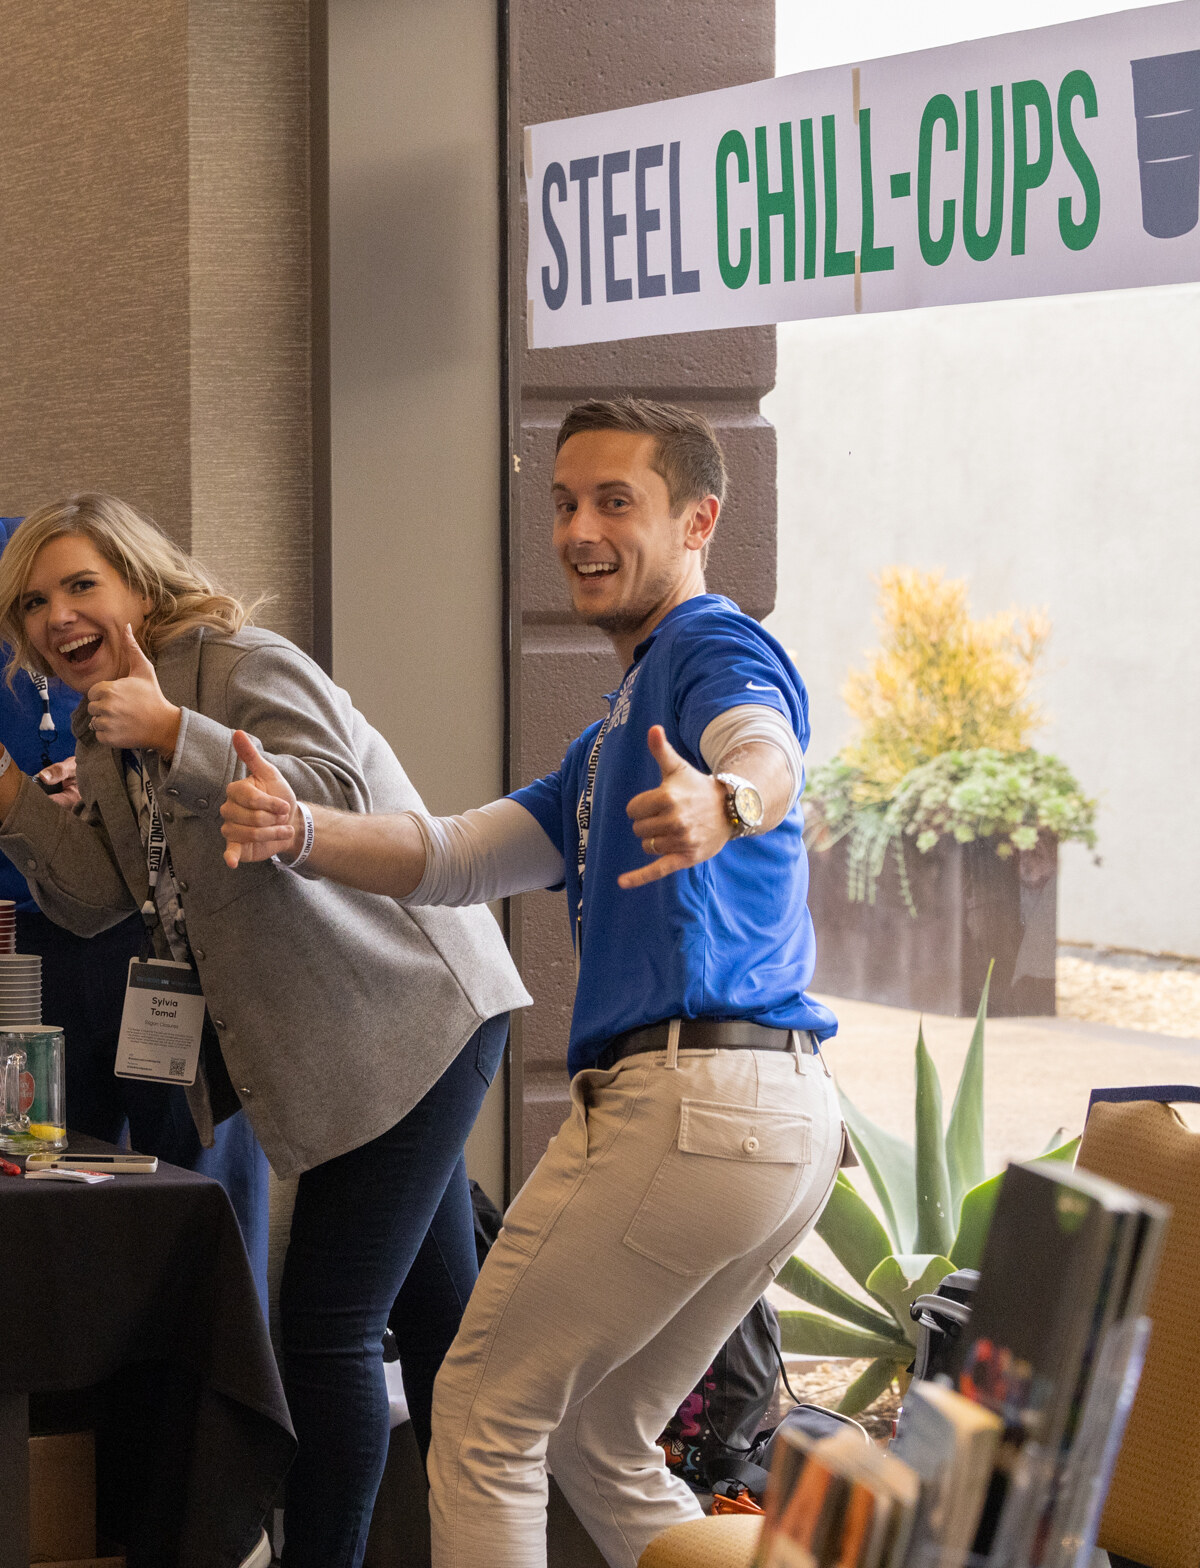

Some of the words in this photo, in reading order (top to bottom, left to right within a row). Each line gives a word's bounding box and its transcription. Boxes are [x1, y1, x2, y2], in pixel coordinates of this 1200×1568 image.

[541, 141, 701, 310] STEEL
[715, 69, 1101, 290] CHILL-CUPS
[152, 997, 178, 1008] Sylvia
[151, 1008, 177, 1019] Tomal
